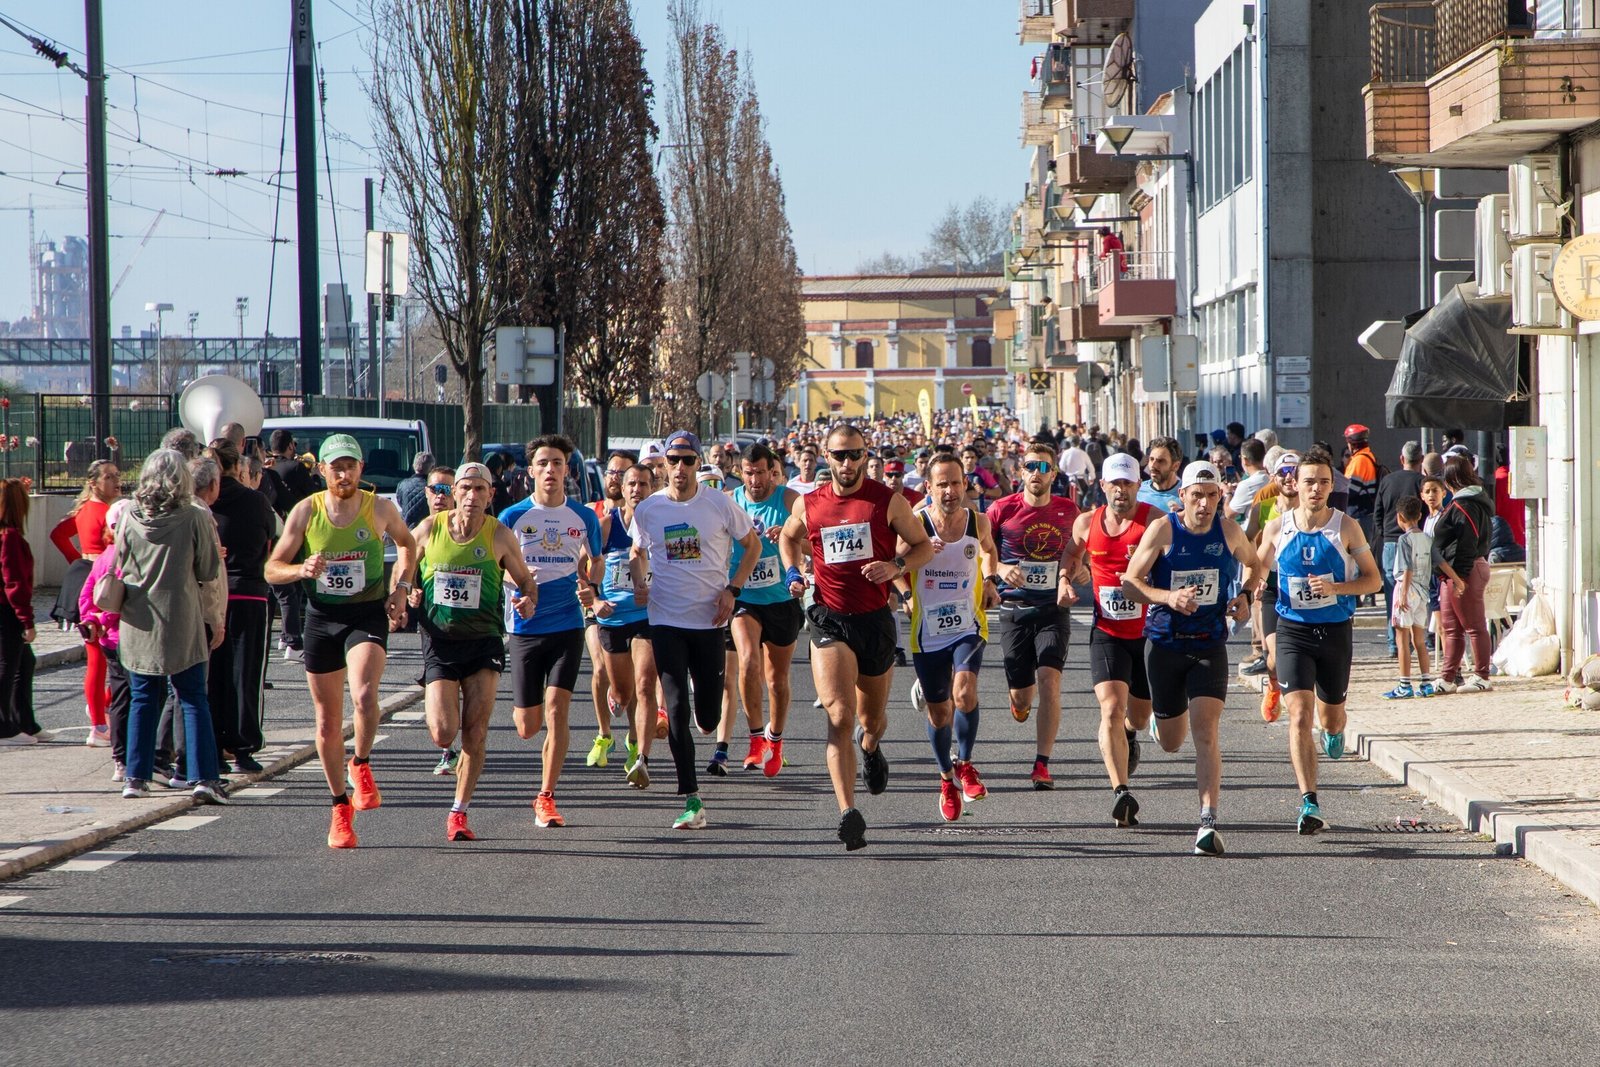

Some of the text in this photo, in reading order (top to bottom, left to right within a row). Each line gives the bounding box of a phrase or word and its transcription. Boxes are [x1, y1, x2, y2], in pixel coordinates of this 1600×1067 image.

[830, 538, 864, 553] 1744
[626, 572, 652, 581] 17
[1026, 574, 1047, 584] 632
[327, 577, 353, 588] 396
[444, 589, 469, 601] 394
[1297, 590, 1329, 601] 134
[1106, 601, 1136, 611] 1048
[937, 615, 962, 628] 299
